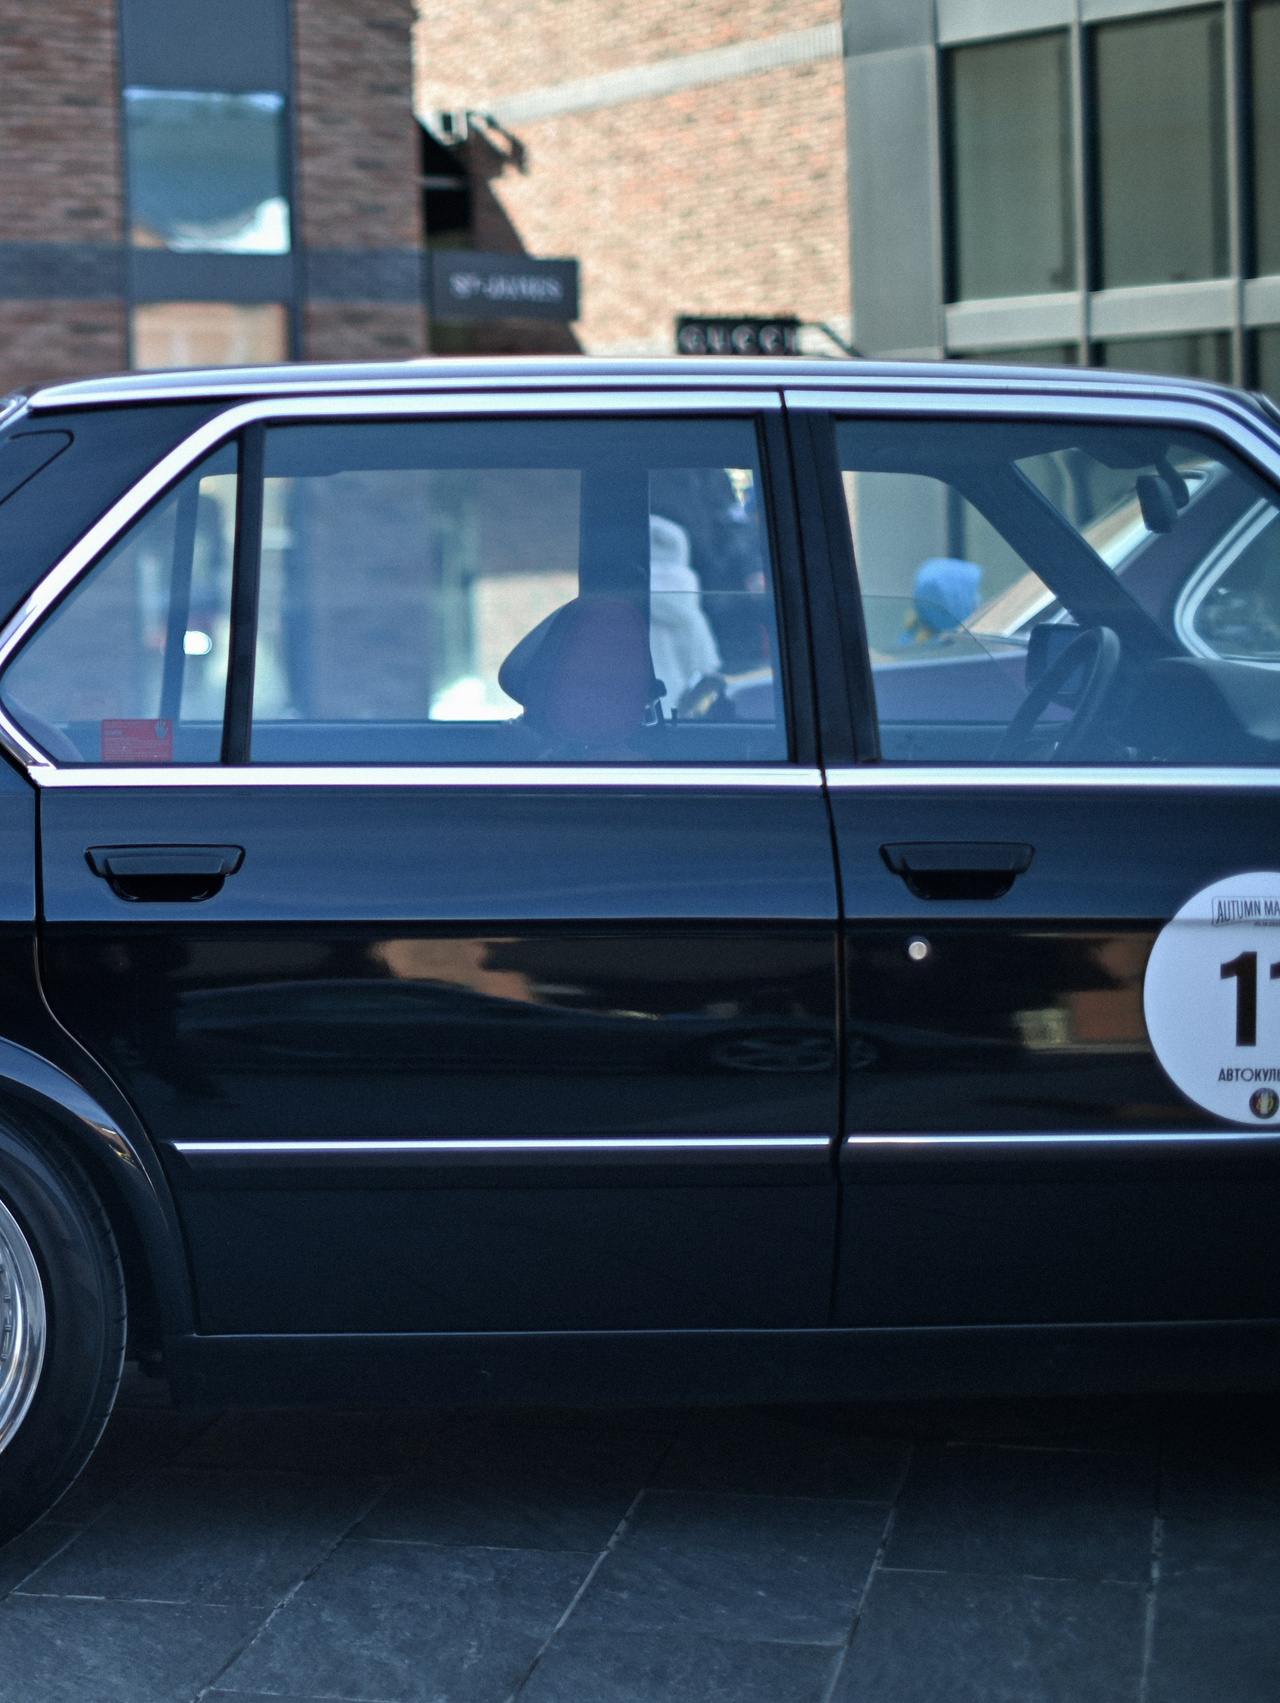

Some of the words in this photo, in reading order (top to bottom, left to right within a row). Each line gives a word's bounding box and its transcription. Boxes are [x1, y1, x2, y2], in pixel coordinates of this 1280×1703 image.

[679, 323, 796, 355] GUCCI
[1216, 900, 1261, 924] AUTUMN
[1220, 951, 1280, 1047] 1
